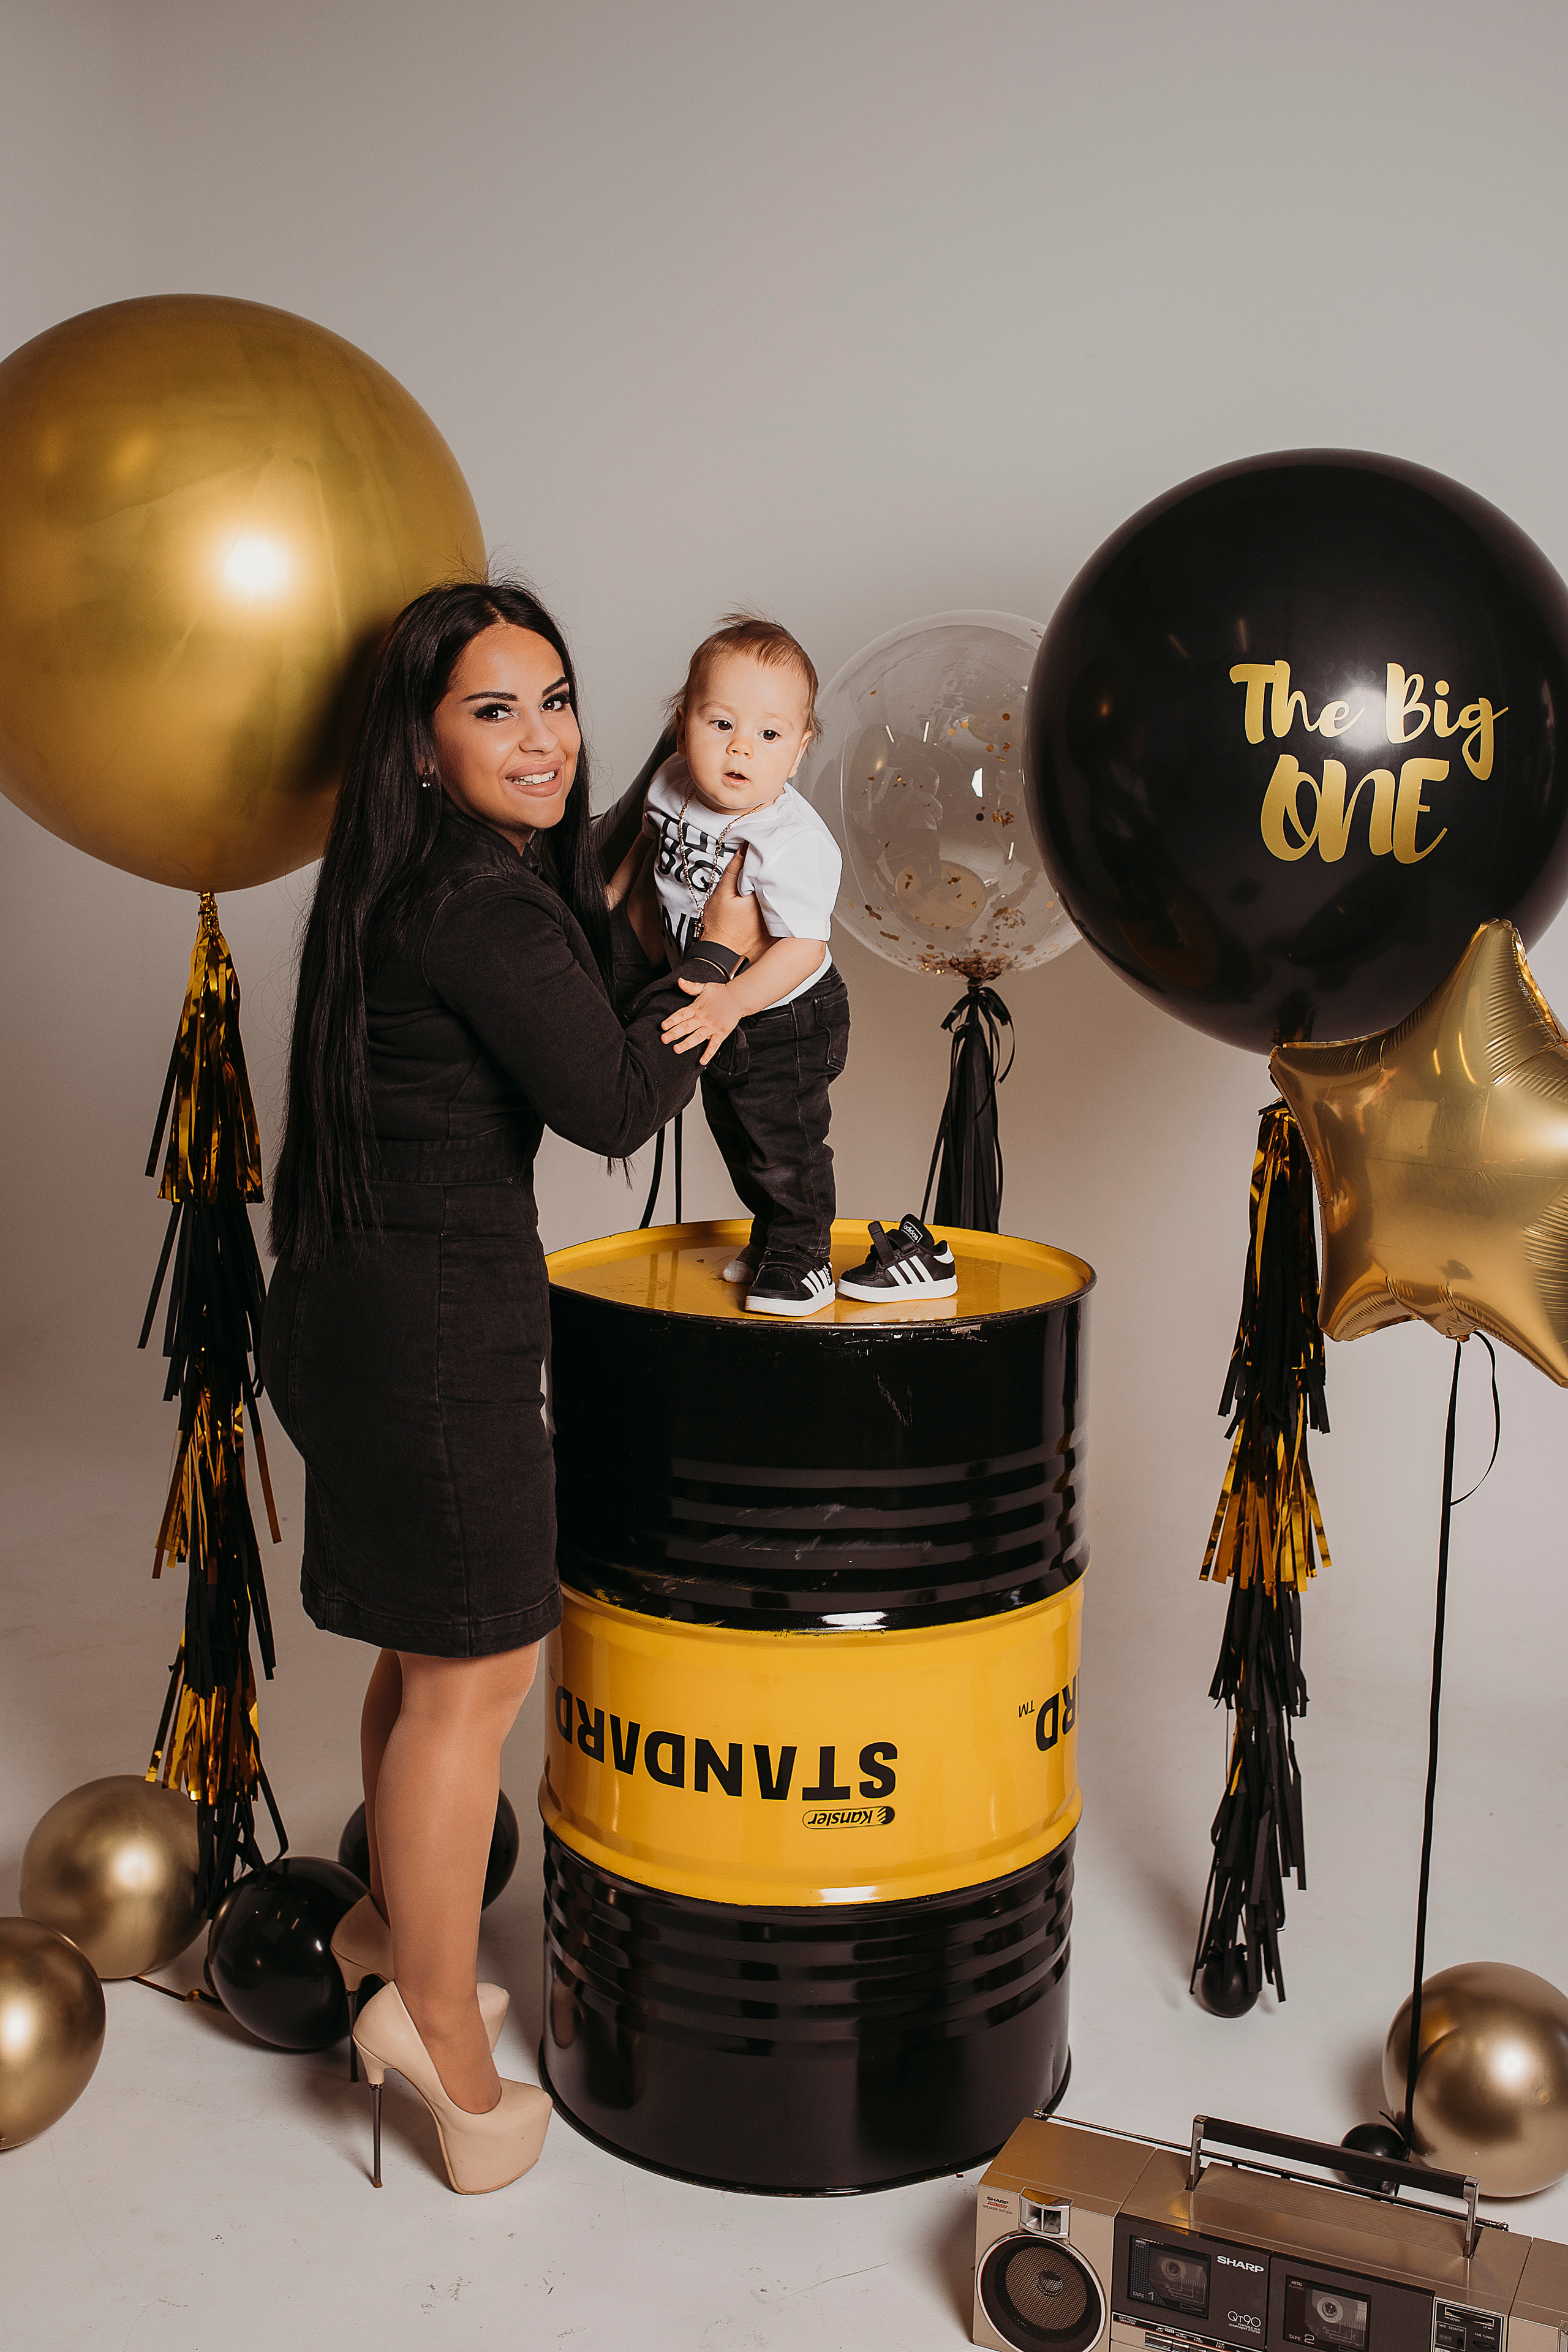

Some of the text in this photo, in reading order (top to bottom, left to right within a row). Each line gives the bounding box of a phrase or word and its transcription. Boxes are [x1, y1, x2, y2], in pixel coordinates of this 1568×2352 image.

[1229, 660, 1509, 781] The Big
[1260, 753, 1450, 864] ONE
[903, 1225, 919, 1240] adidas
[1019, 1668, 1079, 1752] RD TM
[555, 1685, 898, 1801] STANDARD
[807, 1810, 873, 1826] Kansler
[987, 2196, 1009, 2204] SHARP
[1216, 2255, 1264, 2272] SHARP
[1148, 2291, 1153, 2301] 1
[1227, 2311, 1261, 2328] QT90
[1304, 2334, 1315, 2345] 2
